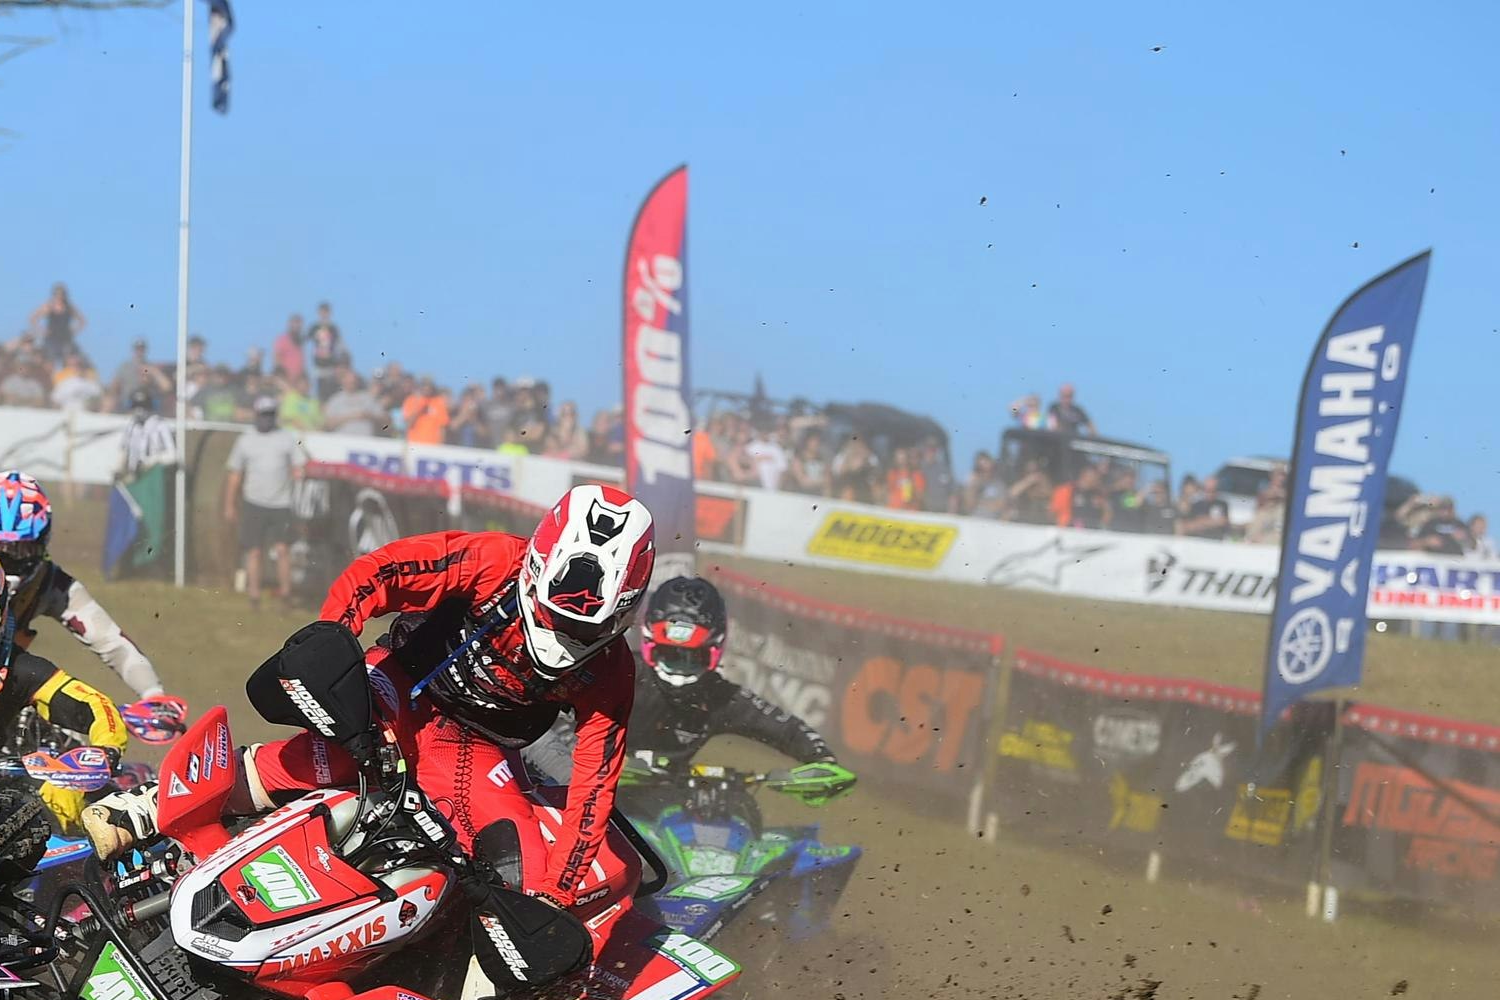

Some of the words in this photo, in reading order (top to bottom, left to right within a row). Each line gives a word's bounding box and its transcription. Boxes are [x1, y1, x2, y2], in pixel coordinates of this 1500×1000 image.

[633, 254, 693, 486] 100%
[347, 452, 512, 490] PARTS
[1290, 325, 1385, 604] YAMAHA
[827, 519, 942, 554] MOOSE
[286, 690, 336, 738] RACING
[289, 679, 336, 725] MOOSE
[841, 656, 987, 774] CST
[249, 860, 308, 909] 400
[278, 914, 388, 975] MAXXIS
[486, 927, 528, 981] RACING
[489, 917, 528, 970] MOOSE
[655, 934, 736, 982] 400
[159, 957, 192, 995] SKIDS
